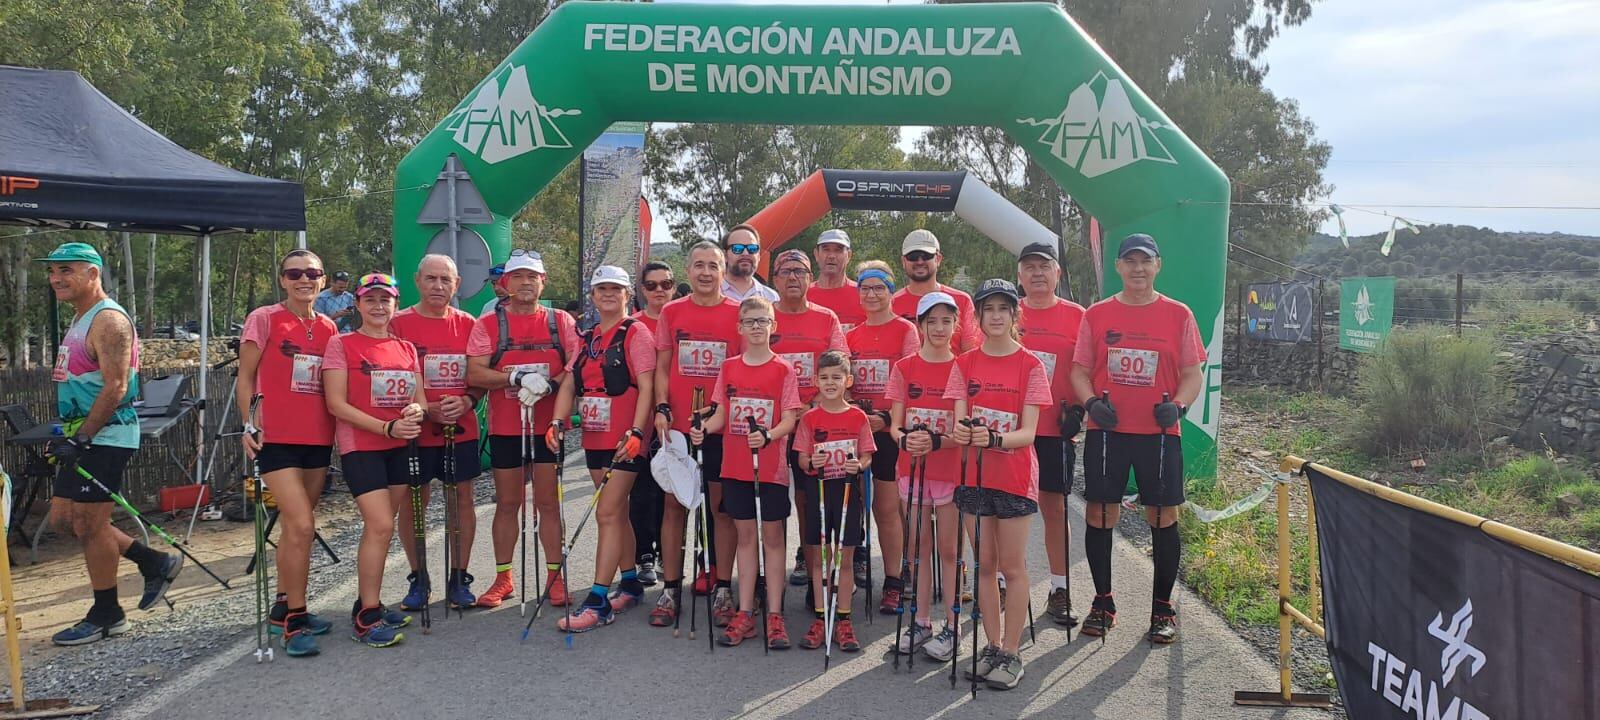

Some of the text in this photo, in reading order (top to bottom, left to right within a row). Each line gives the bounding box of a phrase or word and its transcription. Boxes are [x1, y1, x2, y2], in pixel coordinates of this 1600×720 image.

[583, 21, 1022, 56] FEDERACIÓN ANDALUZA
[648, 58, 952, 96] DE MONTAÑISMO
[462, 107, 540, 155] FAM
[1060, 119, 1139, 168] FAM
[690, 348, 713, 366] 19
[1119, 355, 1145, 375] 90
[438, 361, 460, 378] 59
[857, 366, 877, 383] 91
[385, 378, 407, 396] 28
[582, 403, 599, 421] 94
